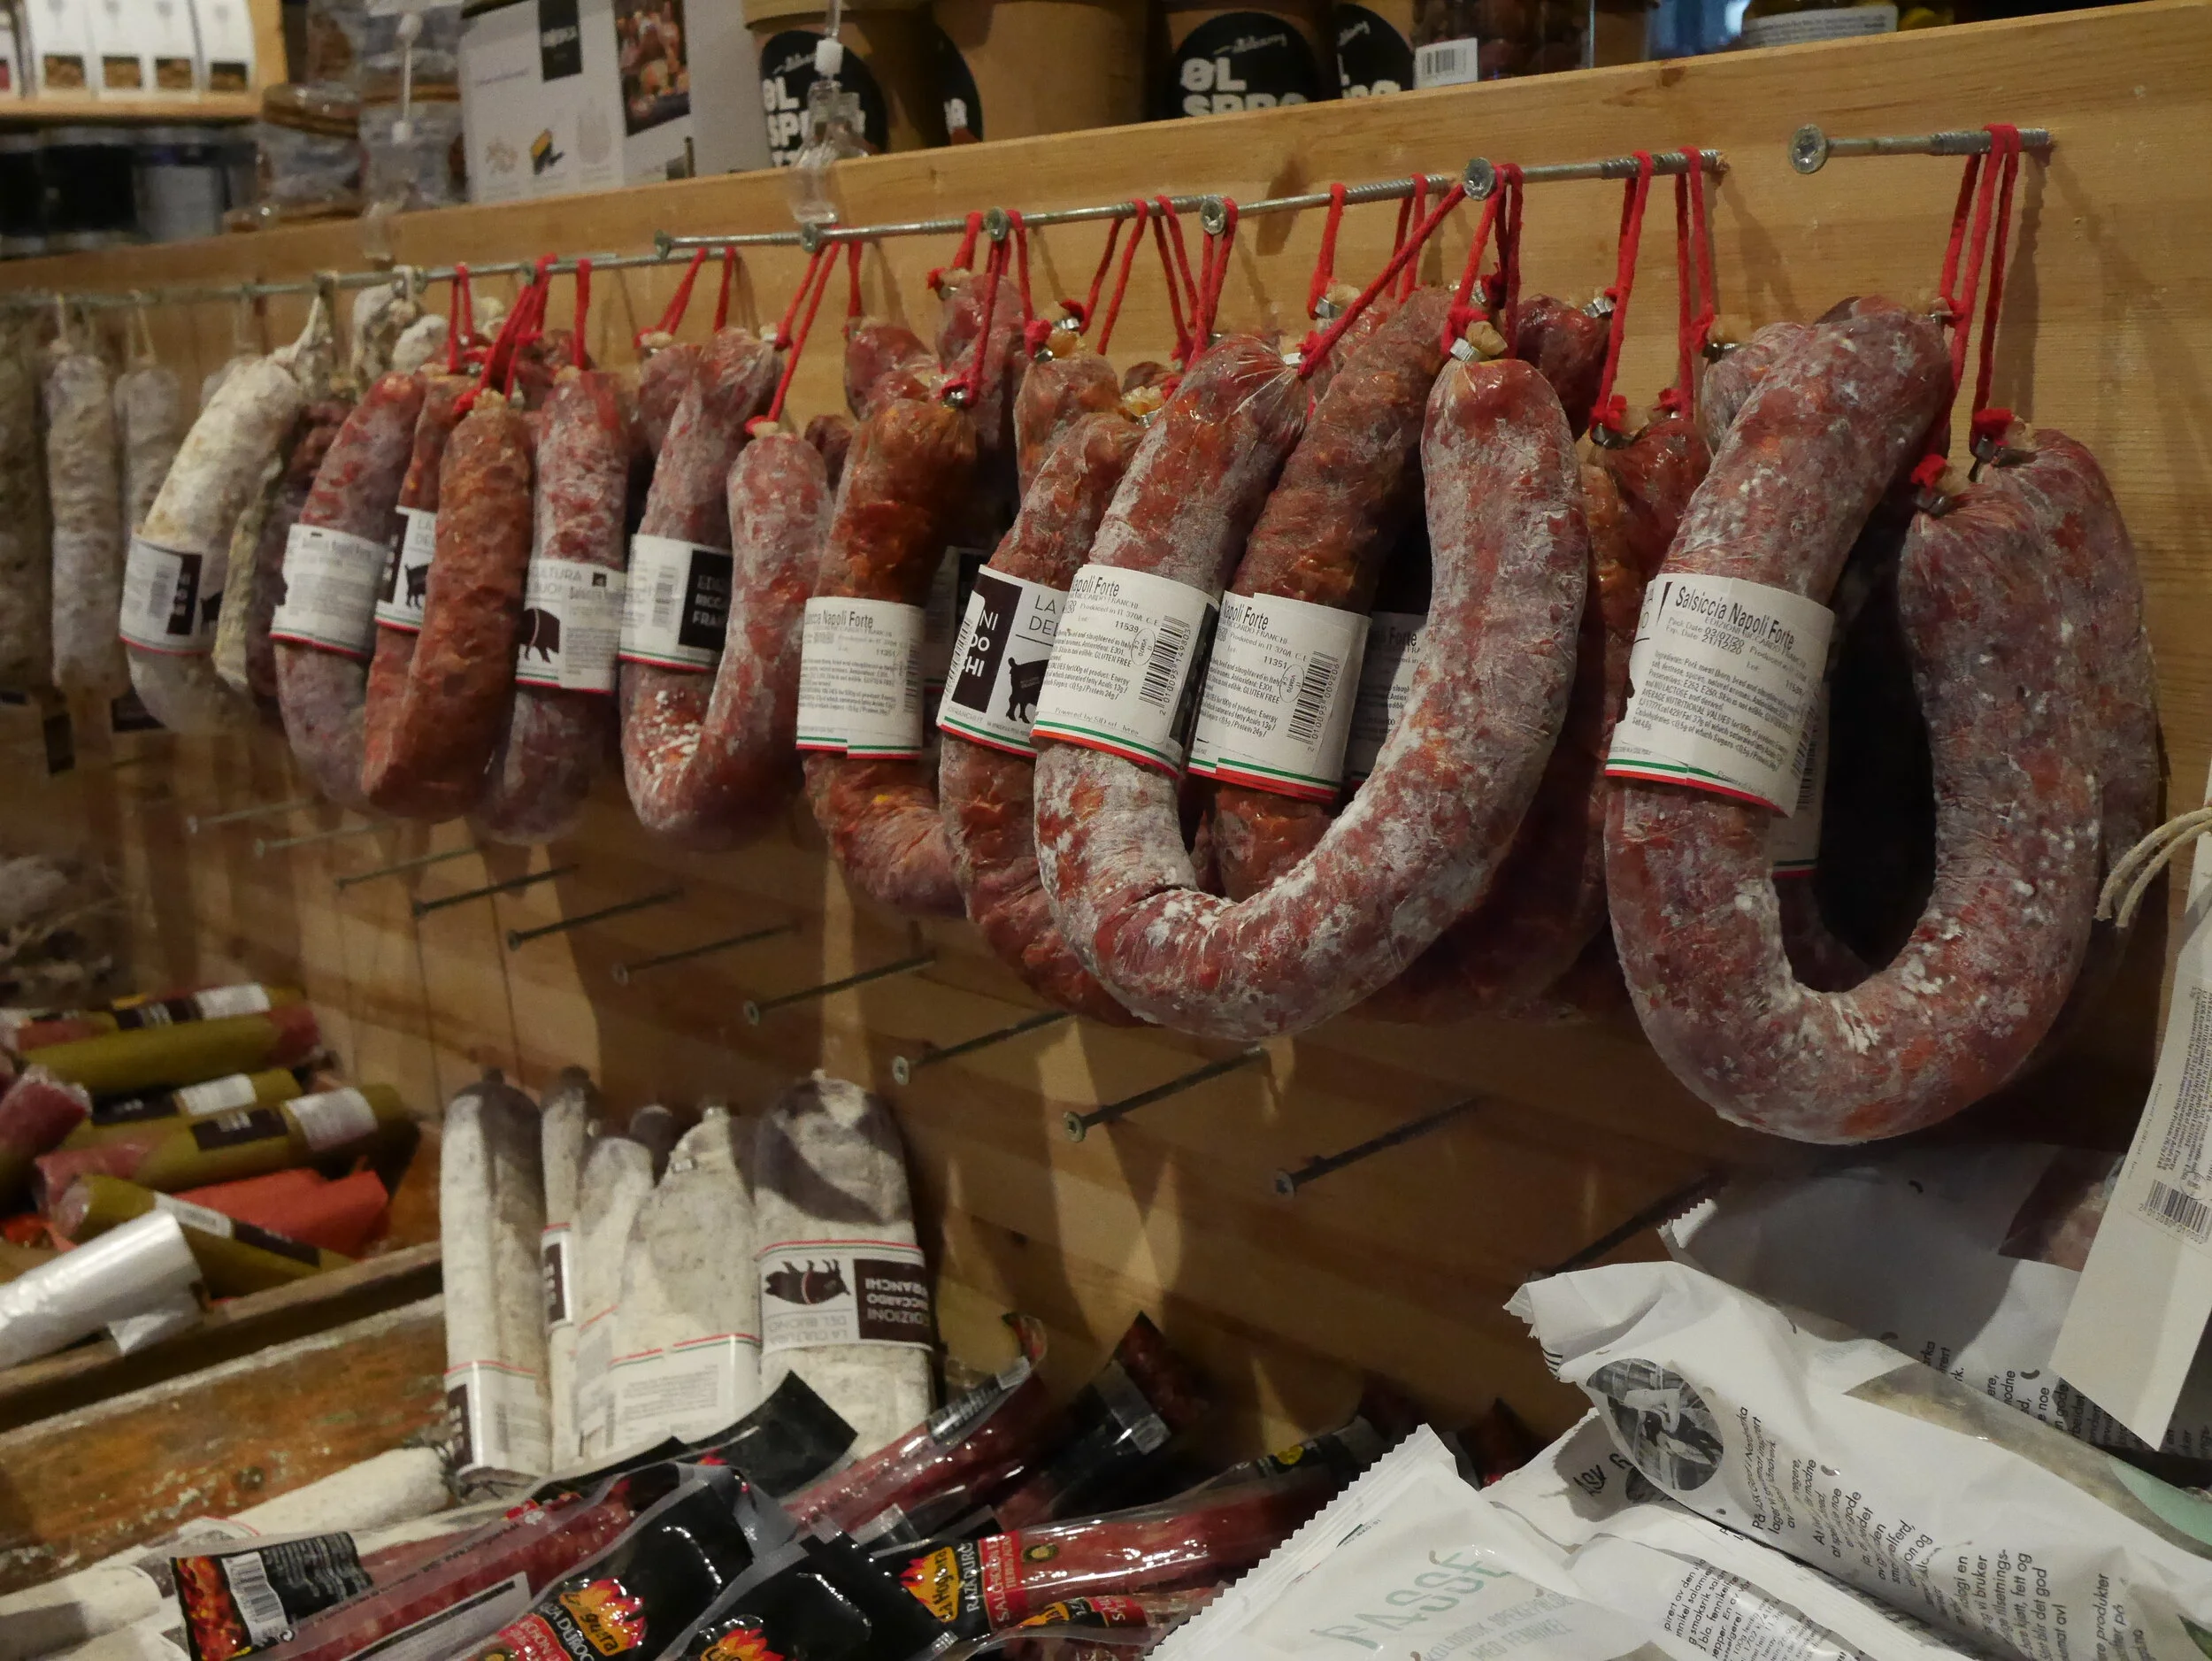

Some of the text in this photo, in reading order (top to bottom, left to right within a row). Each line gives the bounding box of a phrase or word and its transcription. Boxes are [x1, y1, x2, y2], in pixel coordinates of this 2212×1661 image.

[1094, 576, 1119, 597] Forte
[1034, 595, 1056, 614] LA
[849, 611, 873, 629] Forte
[1115, 620, 1139, 633] 11539
[1242, 606, 1269, 631] Forte
[1676, 586, 1794, 650] Salsiccia Napoli Forte
[1701, 634, 1742, 655] 21/12/20
[1703, 627, 1745, 648] 03/07/20
[1094, 651, 1132, 667] GLUTEN FREE
[1264, 656, 1287, 669] 11351
[1110, 673, 1130, 686] Energy
[1243, 686, 1280, 704] GLUTEN FREE
[1258, 710, 1278, 724] Energy
[2039, 1388, 2050, 1411] noe
[1831, 1488, 1842, 1511] noe
[1845, 1492, 1862, 1525] gode
[1752, 1513, 1766, 1529] På
[1886, 1519, 1916, 1553] elferd,
[1916, 1534, 1933, 1549] og
[1957, 1556, 1968, 1573] en
[2017, 1553, 2032, 1573] og
[1675, 1589, 1684, 1602] av
[1681, 1572, 1695, 1588] den
[1687, 1561, 1716, 1603] salamien
[1968, 1555, 1987, 1598] bruker
[2010, 1575, 2026, 1597] fett
[2032, 1566, 2050, 1597] god
[1691, 1593, 1711, 1634] smaksrik
[1722, 1607, 1732, 1620] En
[2031, 1599, 2047, 1620] det
[2092, 1573, 2109, 1642] produkter
